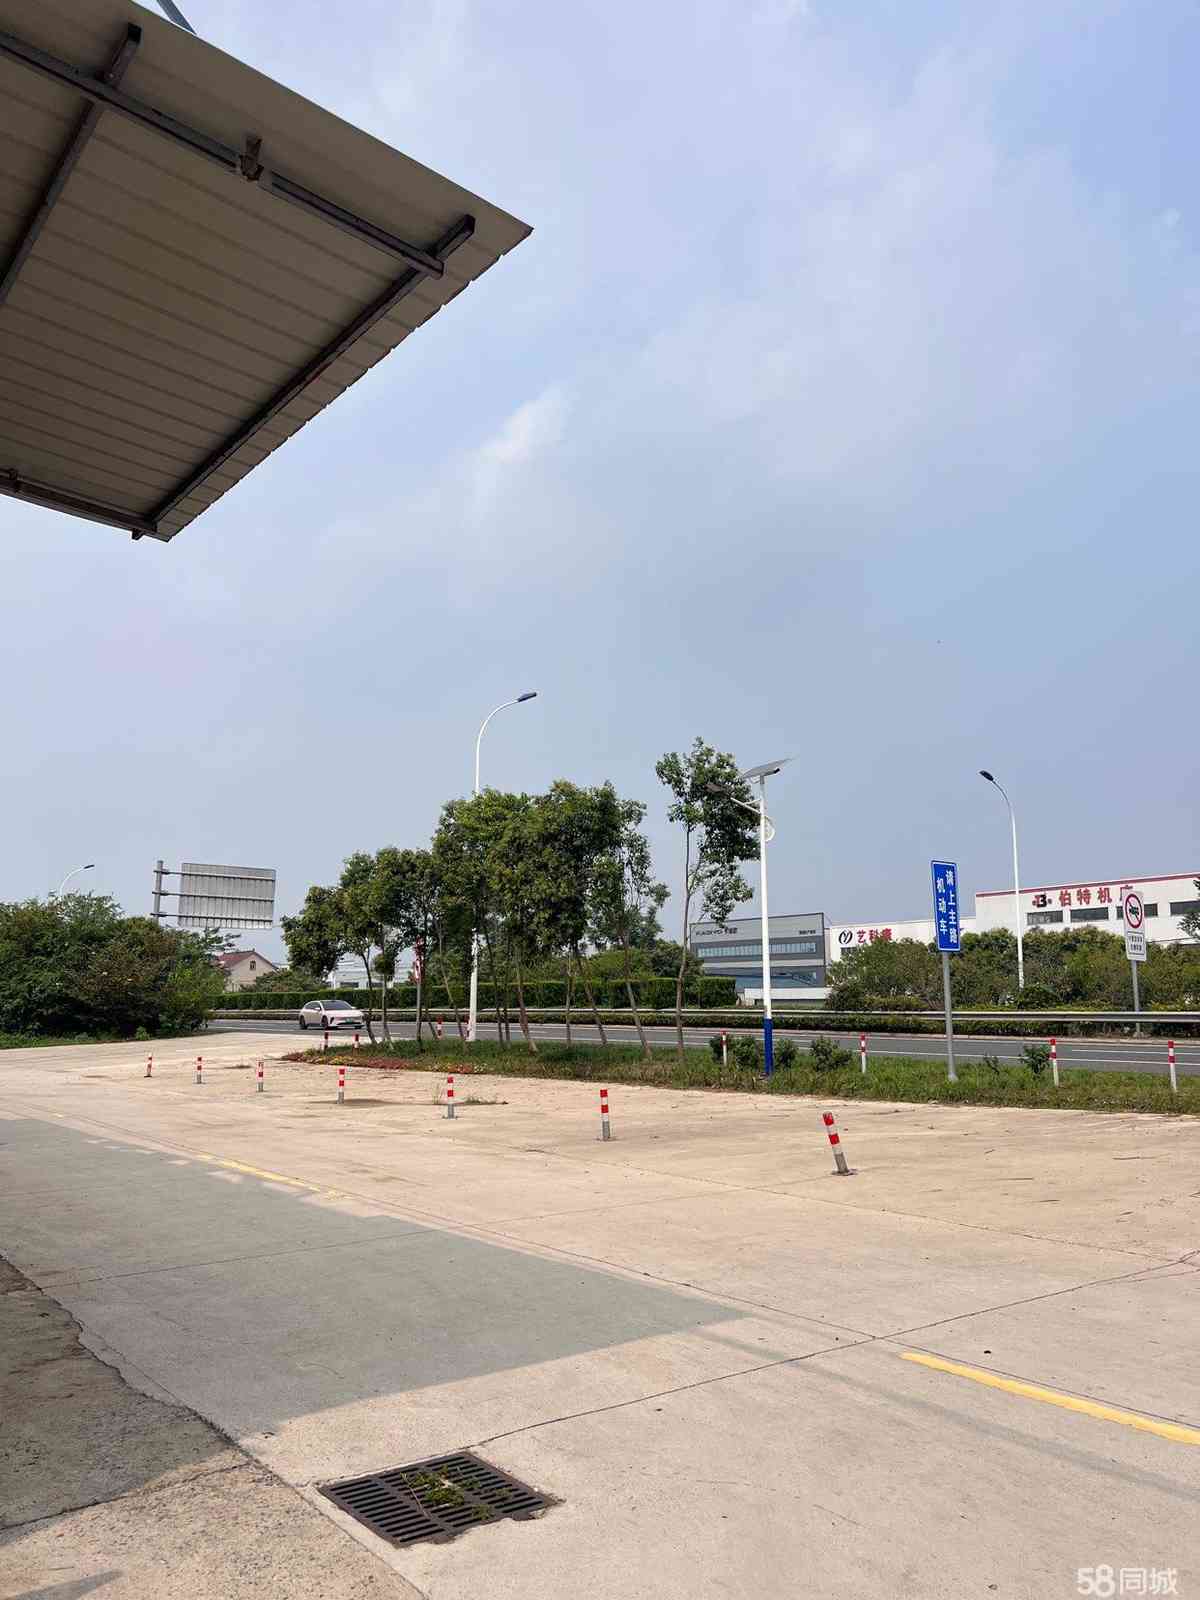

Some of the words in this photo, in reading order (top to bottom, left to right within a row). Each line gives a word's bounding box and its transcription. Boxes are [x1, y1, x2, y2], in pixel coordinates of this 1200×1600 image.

[937, 877, 948, 935] 机动车
[945, 870, 957, 944] 请上主路
